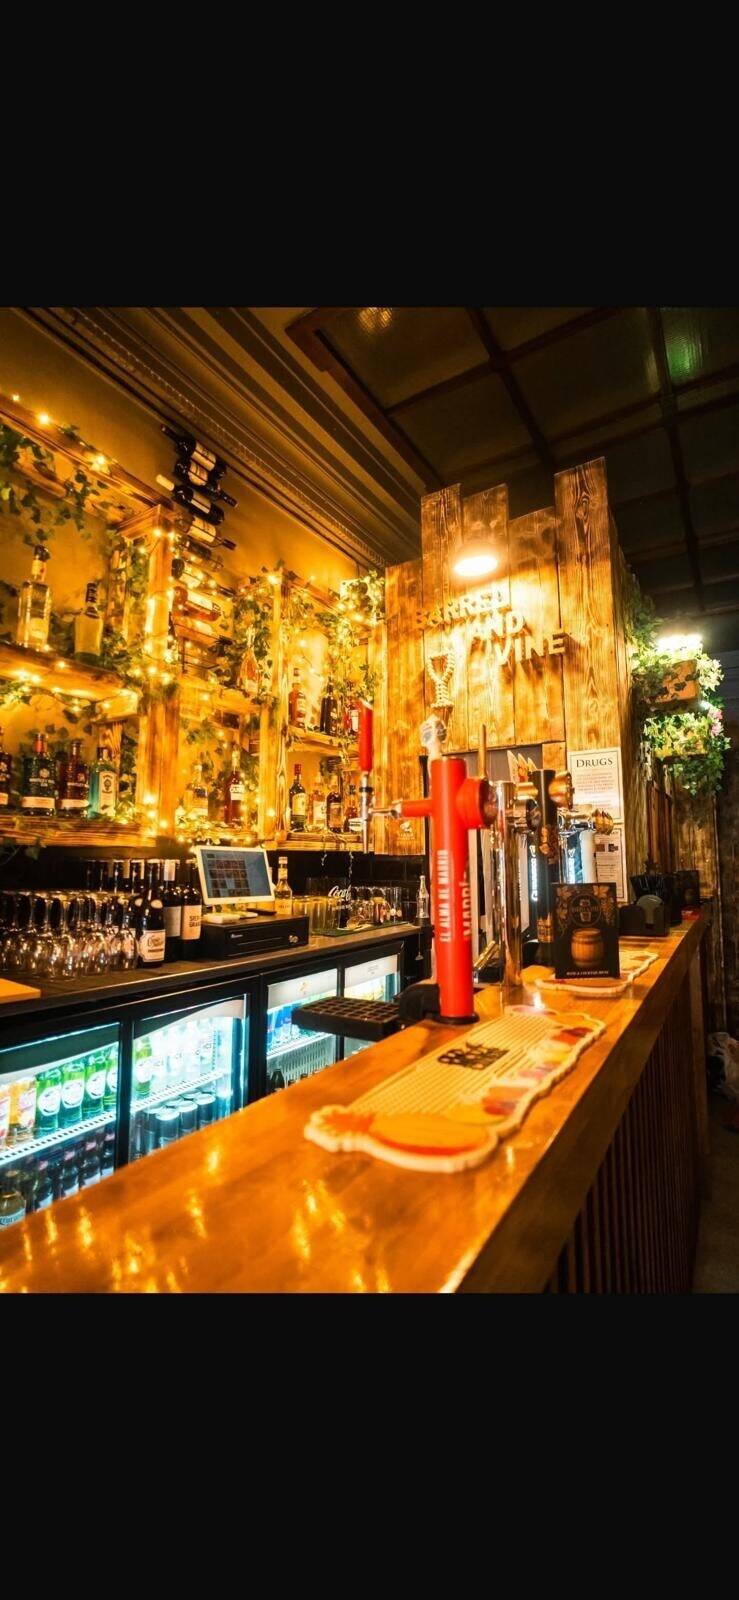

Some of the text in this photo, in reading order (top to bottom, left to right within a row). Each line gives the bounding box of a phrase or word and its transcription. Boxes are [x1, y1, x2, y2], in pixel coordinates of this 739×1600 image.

[470, 610, 525, 641] AND
[494, 631, 566, 665] VINE
[576, 757, 613, 768] DRUGS
[437, 850, 451, 942] EL ALMA DE MADRID
